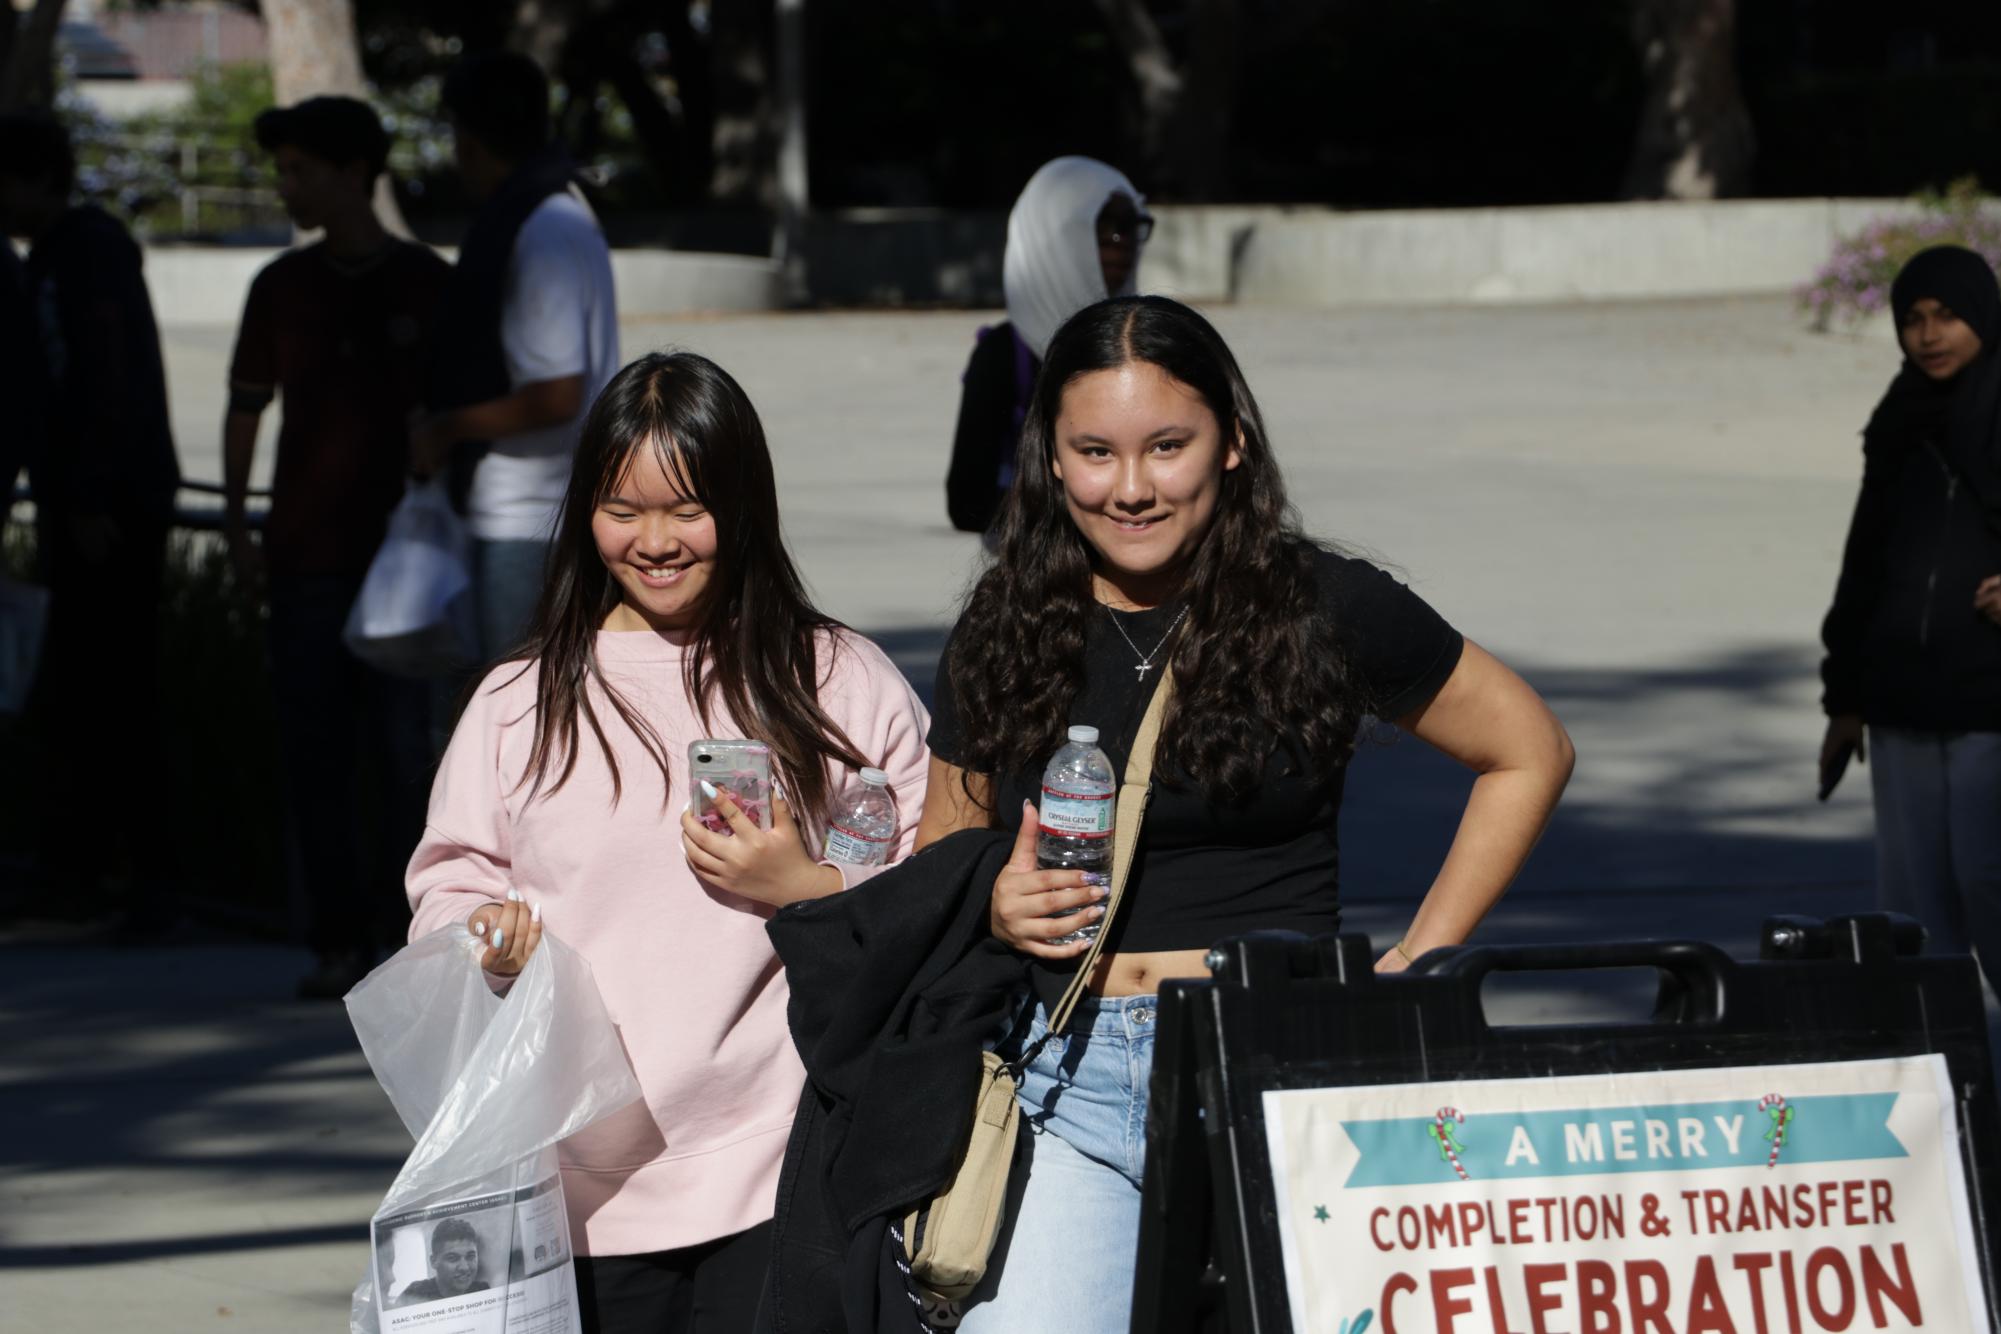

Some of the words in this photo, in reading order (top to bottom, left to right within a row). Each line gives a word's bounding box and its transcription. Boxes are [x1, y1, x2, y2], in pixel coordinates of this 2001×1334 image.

[1504, 1125, 1540, 1166] A
[1563, 1114, 1745, 1164] MERRY
[1370, 1193, 1626, 1252] COMPLETION
[1640, 1192, 1672, 1238] &
[1680, 1179, 1896, 1236] TRANSFER
[1380, 1242, 1924, 1334] CELEBRATION
